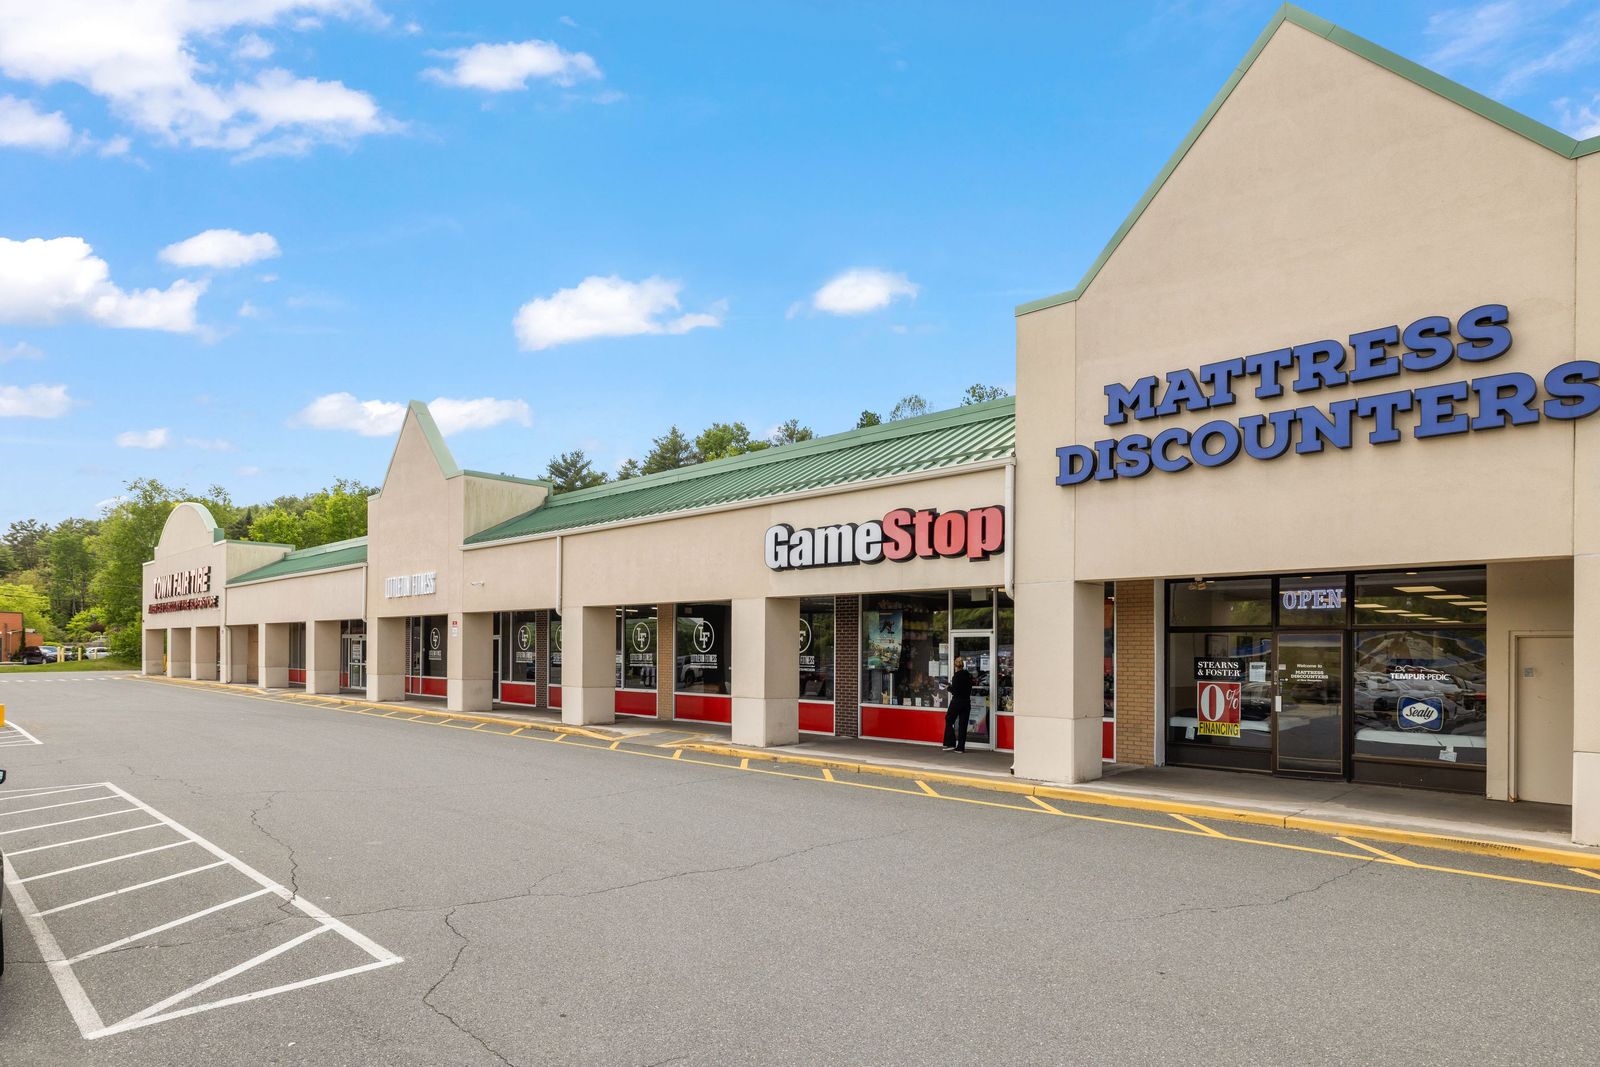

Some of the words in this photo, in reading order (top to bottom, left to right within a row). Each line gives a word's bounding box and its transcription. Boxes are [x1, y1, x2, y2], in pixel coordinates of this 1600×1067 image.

[1103, 303, 1513, 426] MATTRESS
[1055, 360, 1600, 487] DISCOUNTERS
[764, 505, 1006, 573] GameStop
[154, 574, 175, 599] TOWN
[173, 570, 192, 597] FAIR
[190, 566, 211, 593] TIRE
[1283, 589, 1343, 610] OPEN
[1197, 661, 1239, 669] STEARNS
[1205, 669, 1241, 677] FOSTER
[1390, 672, 1452, 681] TEMPUR-PEDIC
[1405, 706, 1435, 720] Sealy
[1199, 722, 1240, 736] FINANCING
